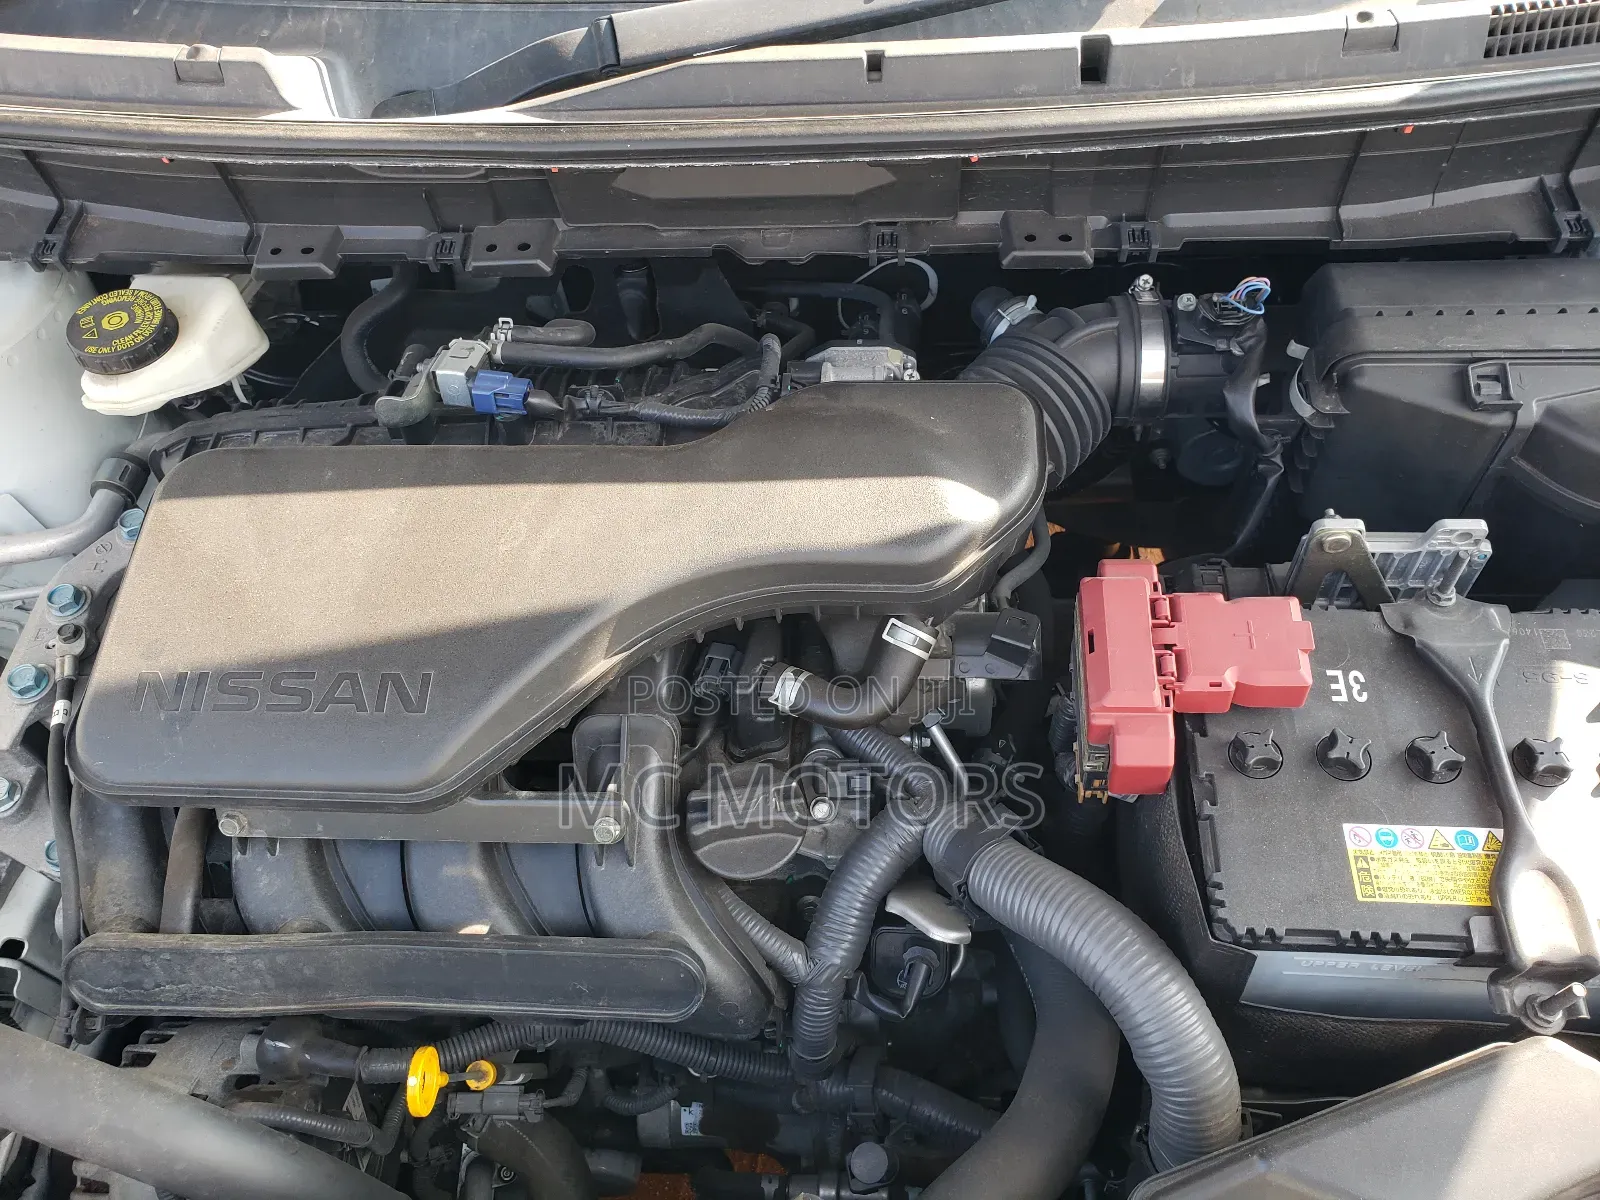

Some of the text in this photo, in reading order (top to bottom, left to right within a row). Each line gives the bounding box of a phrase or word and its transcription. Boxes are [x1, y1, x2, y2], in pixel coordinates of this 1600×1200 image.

[108, 289, 133, 297] SEALED
[139, 290, 152, 300] FROM
[75, 293, 109, 315] CONTAINER
[101, 295, 136, 306] REMOVING
[133, 320, 150, 338] FILLER
[112, 334, 135, 346] CLEAN
[136, 335, 145, 343] OR
[85, 346, 97, 354] USE
[98, 346, 116, 354] ONLY
[1326, 670, 1368, 702] 3E
[130, 670, 434, 714] NISSAN
[1357, 870, 1376, 897] 危険
[1300, 960, 1360, 969] UPPER
